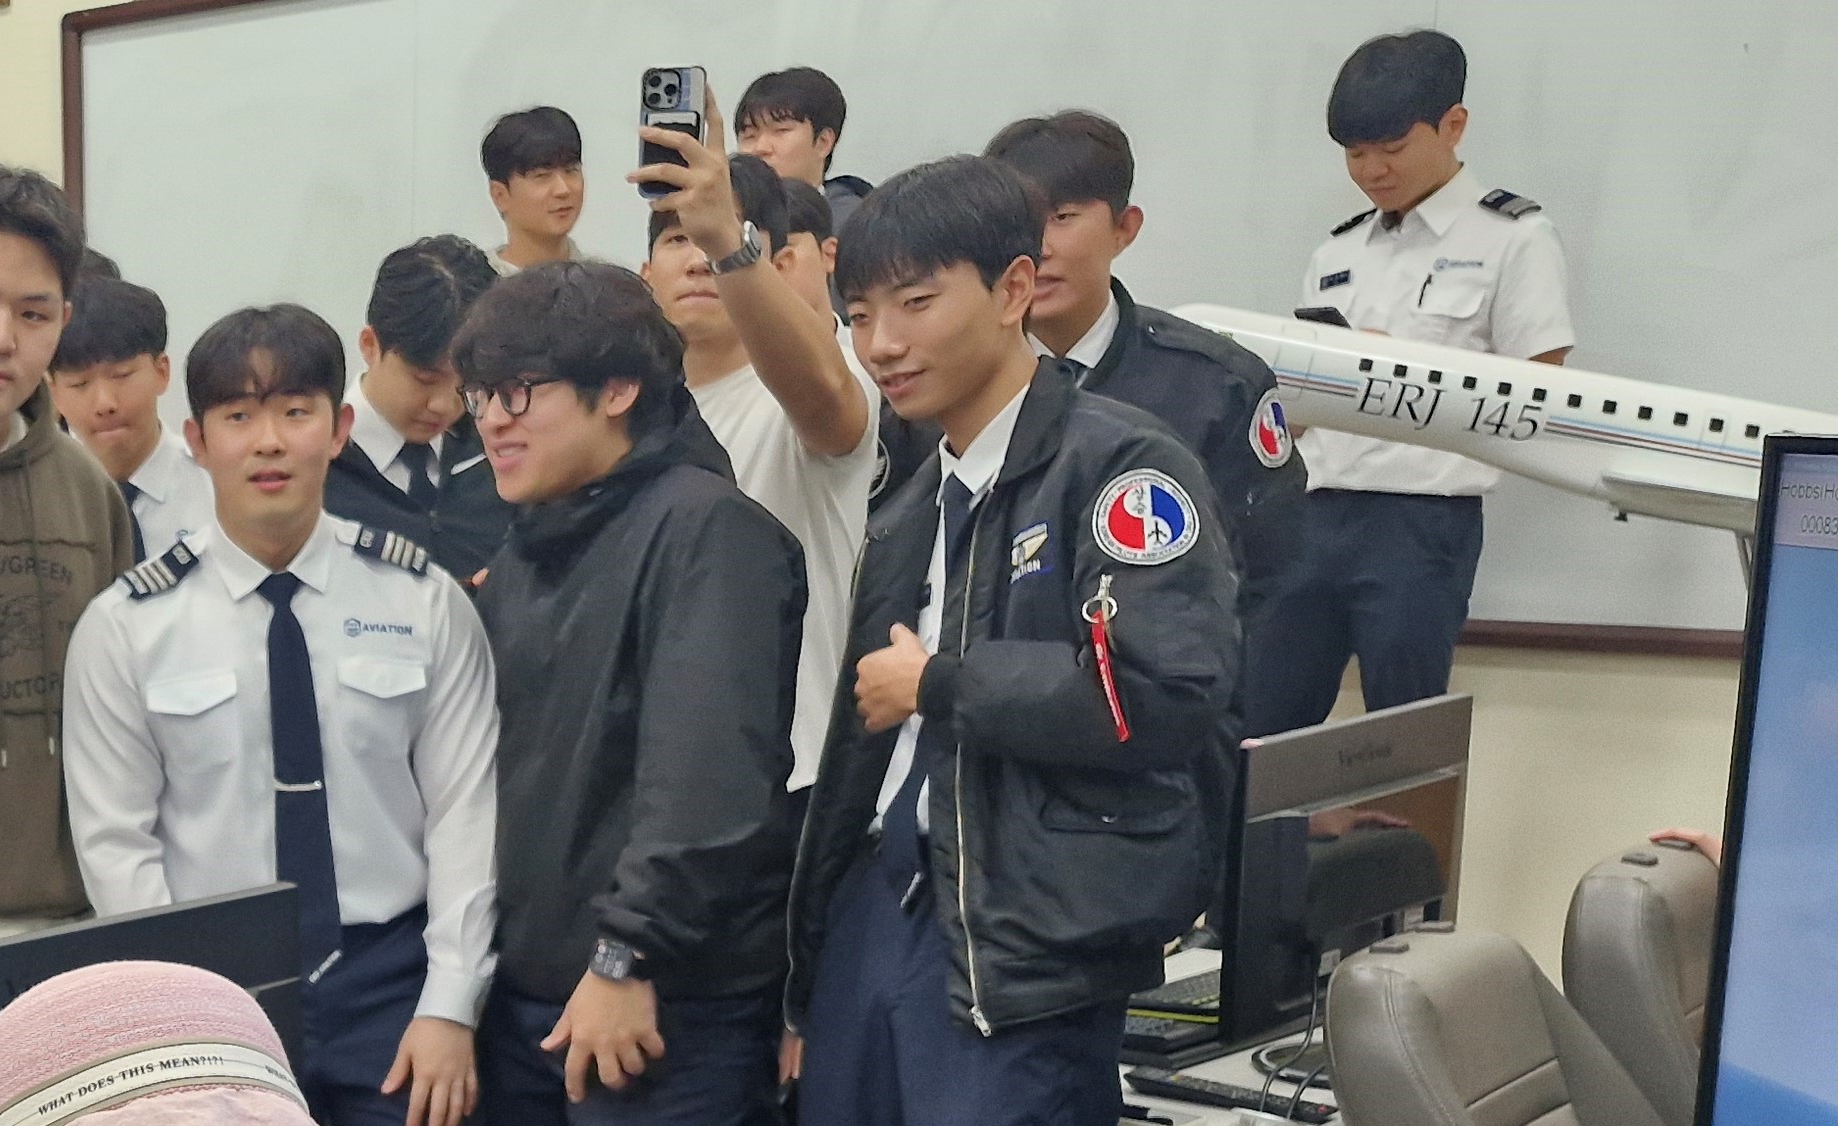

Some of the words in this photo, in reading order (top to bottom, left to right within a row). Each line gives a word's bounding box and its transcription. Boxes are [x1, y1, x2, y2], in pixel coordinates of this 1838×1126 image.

[1357, 377, 1447, 431] ERJ
[1467, 397, 1542, 441] 145
[362, 623, 412, 636] AVIATION
[37, 1091, 75, 1116] WHAT
[78, 1075, 115, 1097] DOES
[118, 1062, 155, 1081] THIS
